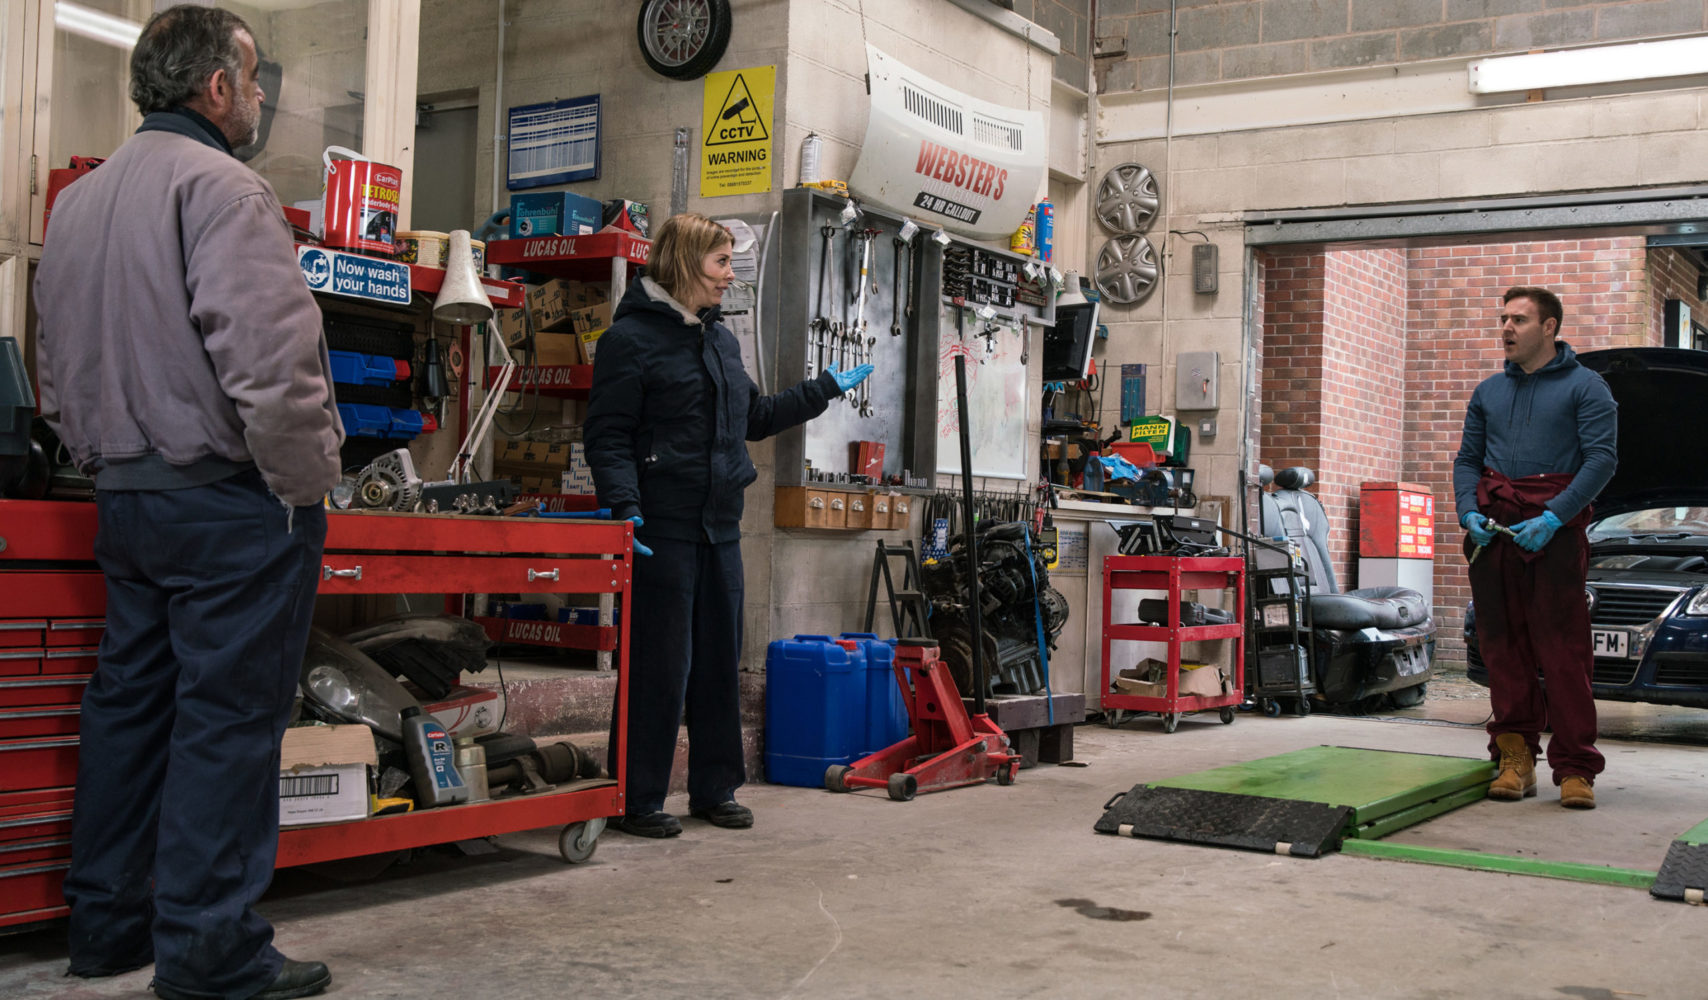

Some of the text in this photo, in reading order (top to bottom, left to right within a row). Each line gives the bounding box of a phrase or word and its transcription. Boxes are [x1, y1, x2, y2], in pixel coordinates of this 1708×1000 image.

[720, 126, 754, 140] CCTV
[708, 148, 766, 166] WARNING
[915, 139, 1008, 201] WEBSTER'S
[920, 195, 977, 222] 24 HR CALLOUT
[523, 238, 576, 257] LUCAS OIL
[630, 241, 649, 260] LUC
[336, 258, 400, 283] Now wash
[336, 277, 407, 299] your hands
[518, 368, 571, 385] LUCAS OIL
[549, 497, 566, 512] OIL
[508, 622, 561, 642] LUCAS OIL
[1593, 632, 1619, 653] FM
[435, 742, 446, 751] R
